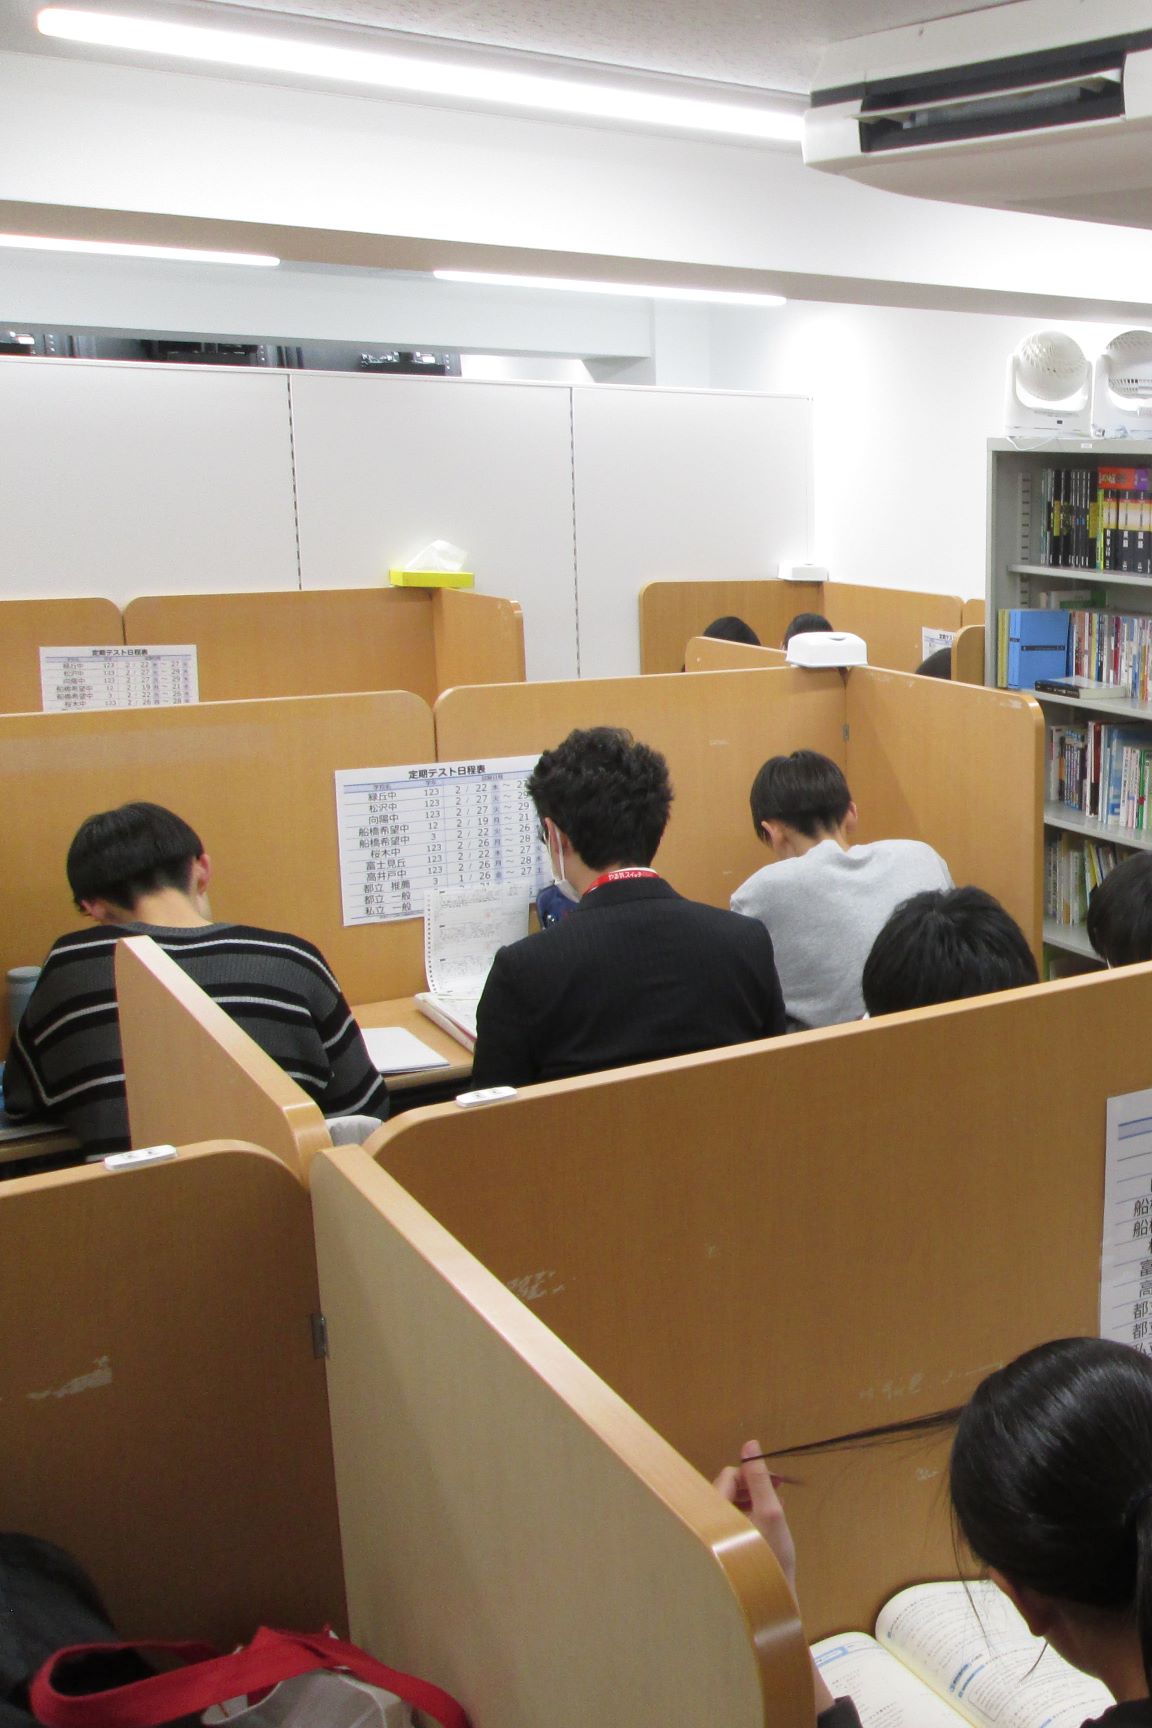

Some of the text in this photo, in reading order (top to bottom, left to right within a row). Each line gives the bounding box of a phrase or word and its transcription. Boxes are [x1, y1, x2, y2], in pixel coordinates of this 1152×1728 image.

[409, 765, 485, 779] 定期テスト日程表
[424, 788, 439, 796] 123
[476, 784, 487, 792] 22
[456, 797, 461, 805] 2
[477, 795, 487, 803] 27
[456, 808, 461, 816] 2
[477, 806, 488, 814] 27
[518, 802, 529, 811] 29
[457, 819, 462, 827] 2
[478, 817, 488, 825] 19
[457, 830, 462, 838] 2
[478, 828, 489, 836] 22
[519, 824, 530, 832] 26
[427, 844, 442, 852] 123
[478, 839, 489, 847] 26
[520, 835, 531, 843] 28
[428, 855, 442, 863] 123
[458, 853, 463, 861] 2
[479, 850, 490, 858] 22
[428, 866, 442, 874] 123
[459, 864, 463, 872] 2
[479, 861, 490, 869] 26
[480, 872, 491, 880] 26
[521, 867, 532, 875] 27
